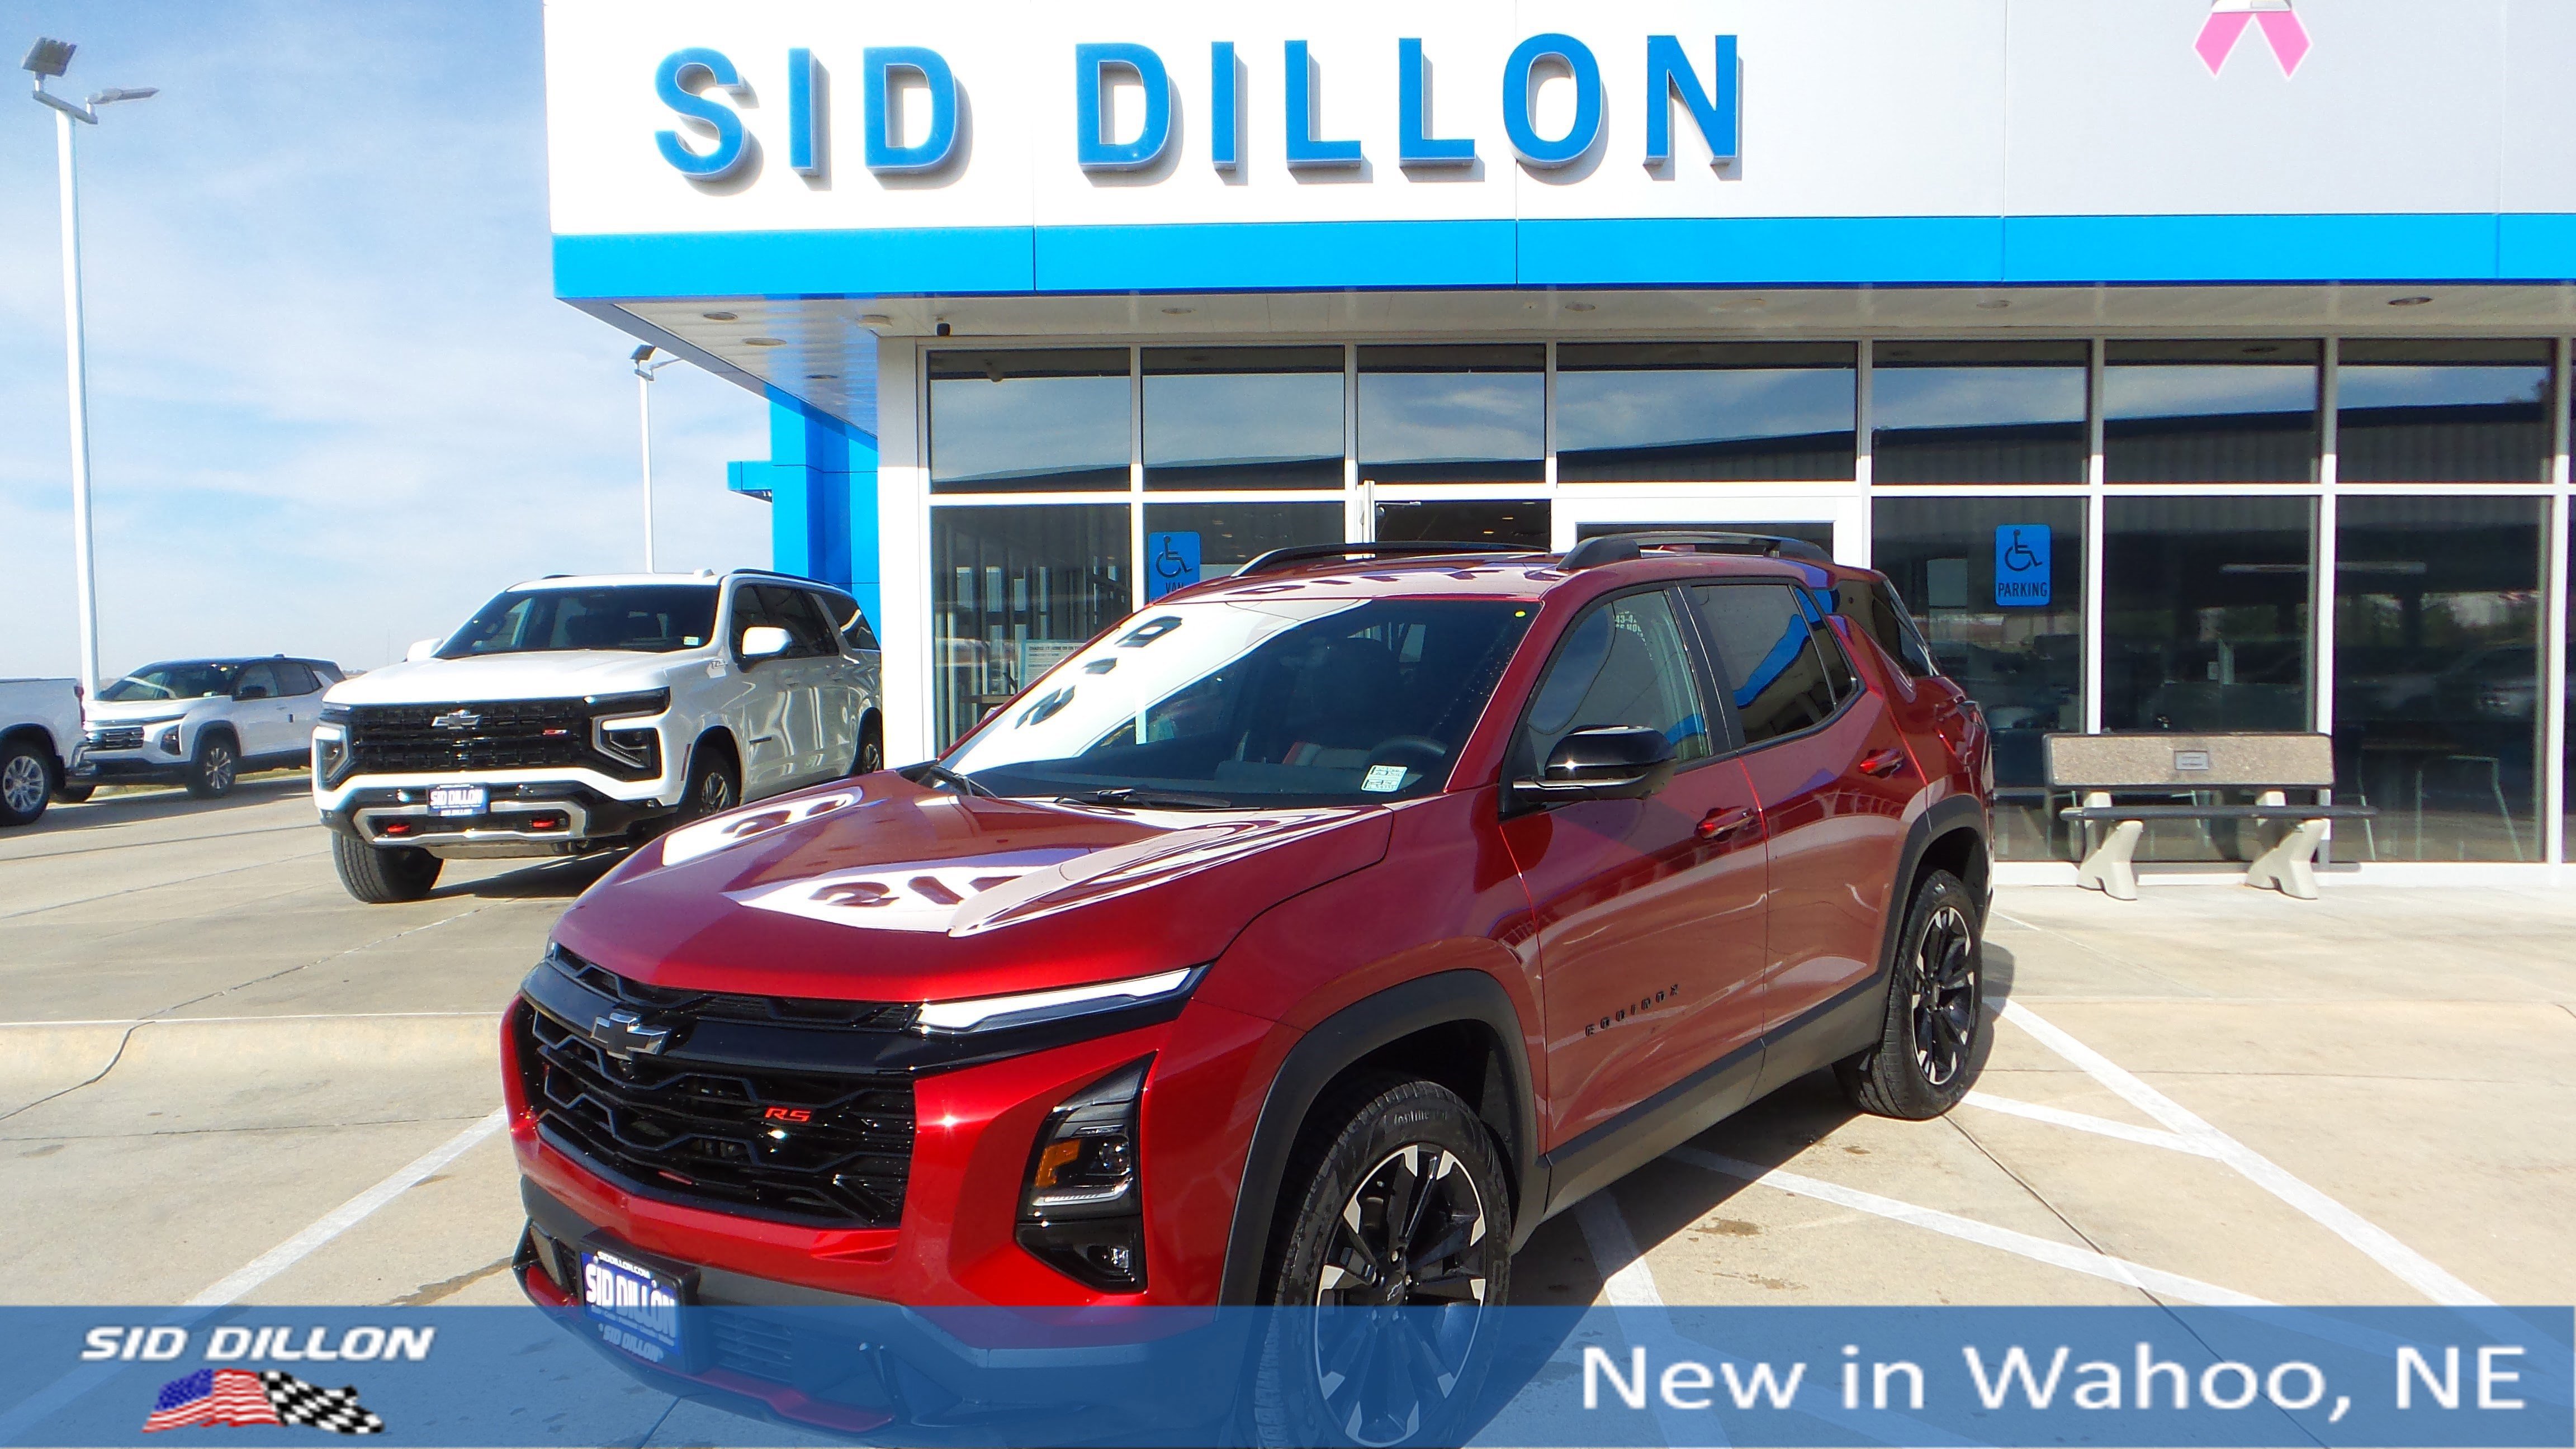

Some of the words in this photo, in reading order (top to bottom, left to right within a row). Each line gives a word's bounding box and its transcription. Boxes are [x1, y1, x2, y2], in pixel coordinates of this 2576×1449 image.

[655, 46, 958, 177] SID
[1075, 33, 1737, 171] DILLON
[1997, 582, 2047, 597] PARKING
[430, 790, 447, 806] SID
[448, 789, 484, 805] DILLON
[1585, 984, 1679, 1037] EQUINOX
[765, 1106, 812, 1123] RS
[585, 1263, 614, 1310] SID
[615, 1275, 676, 1338] DILLON
[603, 1324, 621, 1345] SID
[621, 1332, 660, 1362] DILLON
